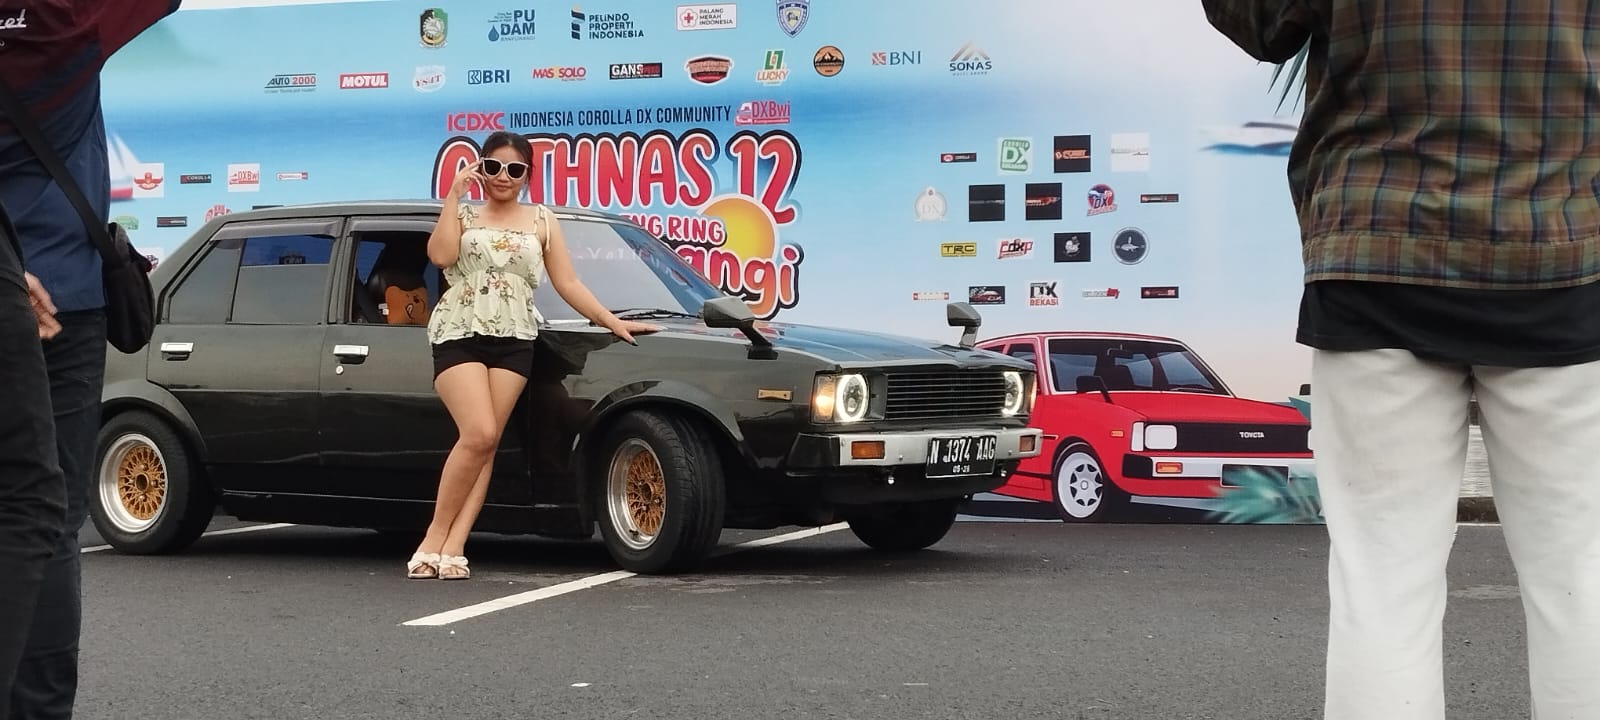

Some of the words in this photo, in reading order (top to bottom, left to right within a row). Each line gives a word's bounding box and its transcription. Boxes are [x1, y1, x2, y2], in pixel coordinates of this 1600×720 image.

[513, 9, 536, 22] PU
[589, 13, 630, 22] PELINDO
[500, 22, 536, 35] DAM
[589, 21, 634, 31] PROPERTI
[589, 30, 644, 40] INDONESIA
[889, 51, 921, 65] BNI
[949, 61, 992, 71] SONAS
[267, 77, 290, 86] AUTO
[292, 76, 316, 85] 2000
[341, 75, 388, 88] MOTUL
[482, 69, 510, 84] BRI
[757, 71, 789, 81] LUCKY
[447, 112, 505, 132] ICDXC
[510, 111, 574, 128] INDONESIA
[578, 109, 632, 126] COROLLA
[635, 108, 652, 124] DX
[656, 105, 731, 124] COMMUNITY
[434, 133, 718, 211] ATHNAS
[730, 132, 797, 224] 12
[667, 214, 725, 243] RING
[944, 245, 975, 254] TRC
[1030, 281, 1058, 298] DX
[1030, 298, 1058, 306] BEKASI
[1239, 431, 1265, 439] TOYOTA
[930, 440, 940, 464] N
[946, 438, 972, 463] 1374
[976, 437, 996, 461] AAG
